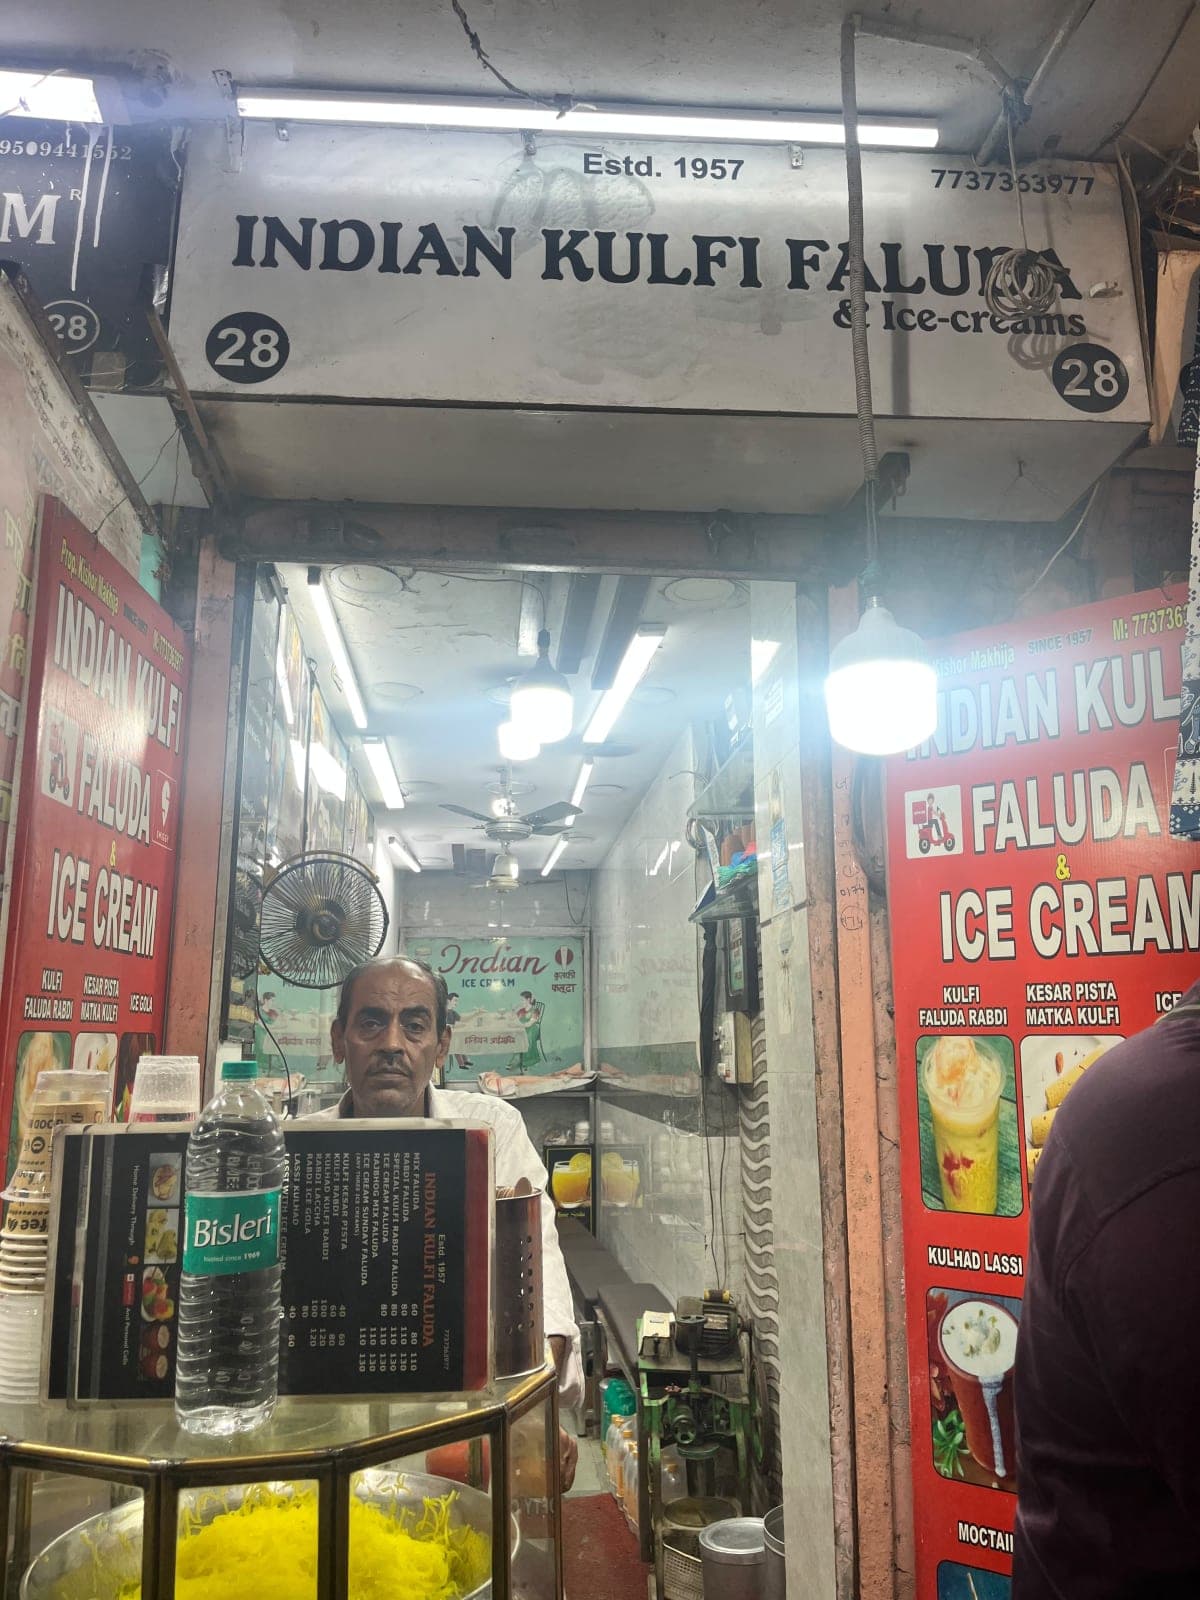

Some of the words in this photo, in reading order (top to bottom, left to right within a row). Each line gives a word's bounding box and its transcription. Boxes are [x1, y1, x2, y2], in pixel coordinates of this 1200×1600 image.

[583, 152, 662, 178] Estd.
[673, 157, 745, 180] 1957
[931, 168, 1095, 196] 7737363977
[231, 214, 517, 281] INDIAN
[540, 228, 763, 289] KULFI
[785, 238, 1083, 300] FALUDA
[47, 313, 88, 341] 28
[832, 298, 871, 329] &
[881, 299, 1087, 337] Ice-creams
[213, 327, 281, 369] 28
[1060, 358, 1119, 398] 28
[1027, 636, 1063, 656] SINCE
[1065, 628, 1094, 648] 1957
[1111, 618, 1129, 641] M:
[53, 583, 131, 712] INDIAN
[134, 653, 183, 754] KULFI
[906, 668, 1061, 762] NDIAN
[1073, 648, 1184, 734] KUL
[77, 733, 151, 845] FALUDA
[971, 761, 1163, 855] FALUDA
[109, 839, 117, 868] &
[1055, 853, 1072, 881] &
[47, 850, 91, 942] ICE
[93, 867, 159, 958] CREAM
[939, 886, 1017, 963] ICE
[1028, 870, 1200, 958] CREAM
[437, 943, 552, 976] Indian
[41, 968, 63, 992] KULFI
[83, 974, 104, 997] KESAR
[104, 977, 120, 999] PISTA
[461, 977, 477, 989] ICE
[479, 977, 516, 989] CRAM
[1025, 982, 1073, 1003] KESAR
[1075, 981, 1118, 1002] PISTA
[23, 996, 52, 1019] FALUDA
[52, 998, 73, 1020] RABDI
[942, 985, 981, 1005] KULFI
[80, 1001, 101, 1022] MATKA
[102, 1002, 118, 1023] KULFI
[918, 1009, 966, 1027] FALUDA
[968, 1008, 1008, 1026] RABDI
[1025, 1007, 1075, 1027] MATKA
[1077, 1006, 1121, 1027] KULFI
[324, 1152, 332, 1193] KULHAD
[362, 1171, 370, 1204] CREAM
[424, 1172, 436, 1229] INDIAN
[193, 1207, 272, 1248] Bisleri
[360, 1248, 368, 1286] FALUDA
[424, 1233, 436, 1281] KULFI
[927, 1244, 982, 1271] KULHAD
[983, 1251, 1025, 1277] LASSI
[438, 1262, 446, 1284] 1957
[289, 1305, 296, 1319] 40
[339, 1304, 346, 1318] 40
[410, 1304, 418, 1316] 60
[422, 1284, 436, 1348] FALUDA
[288, 1334, 295, 1348] 60
[328, 1334, 336, 1346] 80
[338, 1333, 346, 1346] 60
[410, 1332, 418, 1345] 80
